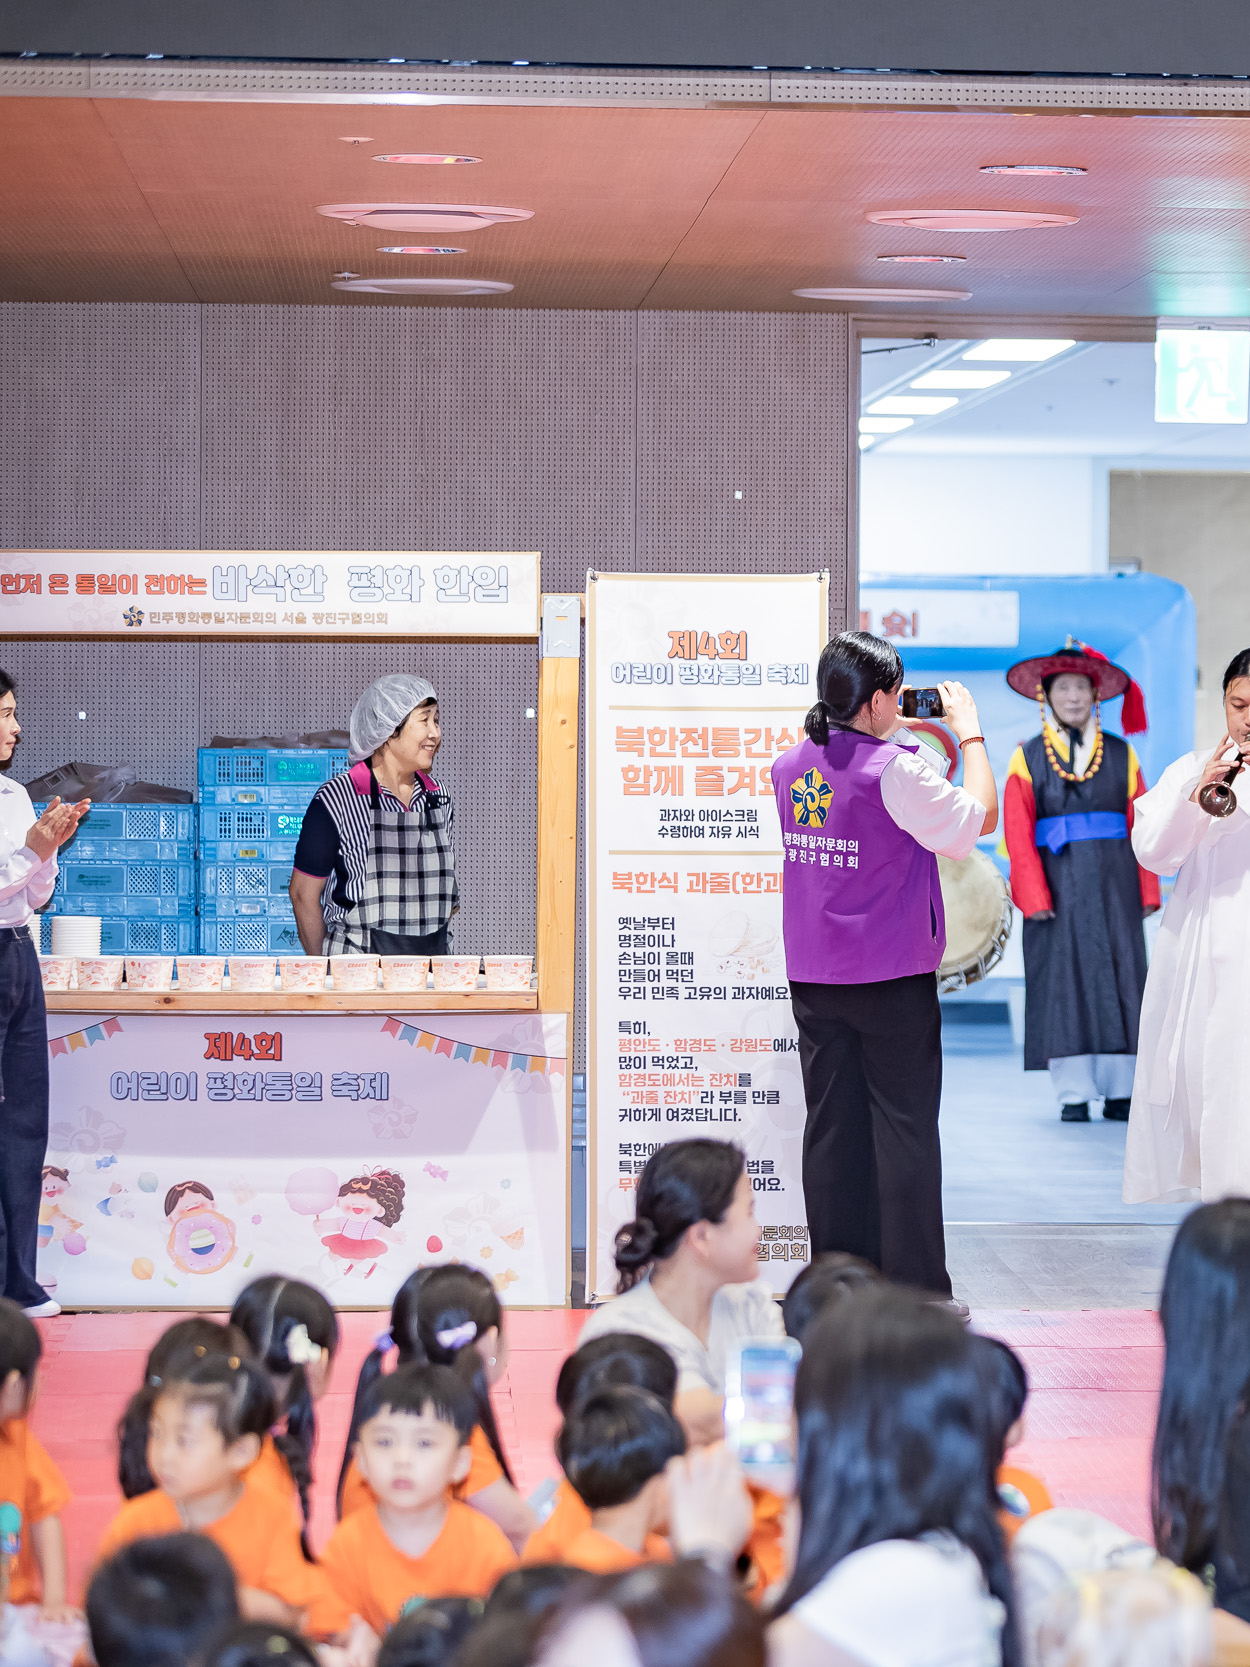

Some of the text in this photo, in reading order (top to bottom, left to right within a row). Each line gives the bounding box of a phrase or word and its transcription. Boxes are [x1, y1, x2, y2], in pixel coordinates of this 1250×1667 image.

[0, 563, 509, 604] 먼저 온 통일이 전하는 바삭한 평화 한입
[149, 612, 387, 624] 민주평화통일자문회의 서울 광진구협의회
[668, 630, 747, 660] 제4회
[612, 663, 808, 685] 어린이 평화통일 축제
[621, 765, 683, 796] 함께
[660, 809, 757, 822] 과자와 아이스크림
[658, 825, 759, 839] 수령하여 자유 시식
[612, 872, 678, 893] 북한식
[618, 917, 675, 930] 옛날부터
[619, 934, 676, 948] 명절이나
[618, 952, 694, 965] 손님이 올때
[619, 969, 694, 983] 만들어 먹던
[618, 986, 646, 1000] 우리
[652, 986, 679, 1000] 민족
[684, 986, 726, 1000] 고유의
[618, 1021, 650, 1036] 특히,
[204, 1032, 282, 1061] 제4회
[619, 1039, 661, 1052] 평안도
[674, 1039, 716, 1052] 함경도
[729, 1038, 800, 1053] 강원도에서
[619, 1056, 698, 1071] 많이 먹었고,
[110, 1071, 389, 1101] 어린이 평화통일 축제
[619, 1073, 752, 1087] 함경도에서는 잔치를
[719, 1091, 747, 1104] 부를
[752, 1090, 780, 1104] 만큼
[619, 1108, 741, 1122] 귀하게 여겼답니다.
